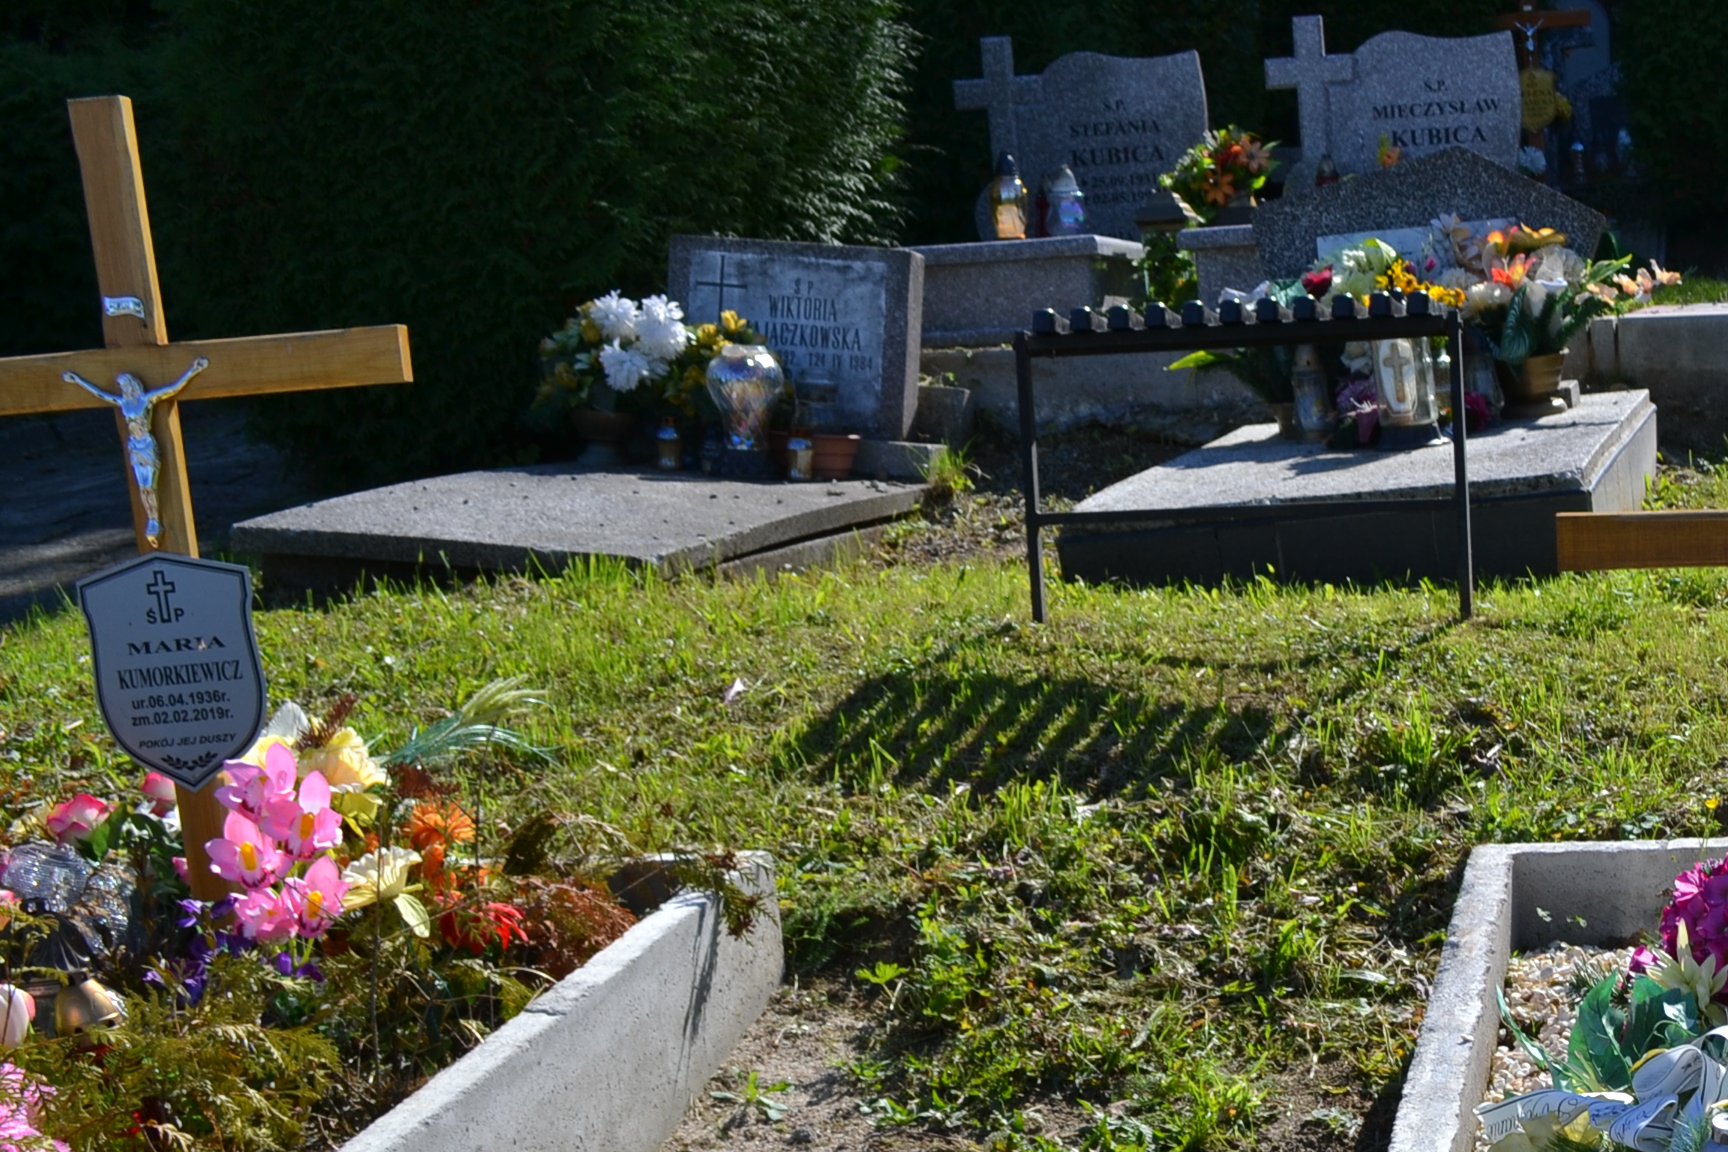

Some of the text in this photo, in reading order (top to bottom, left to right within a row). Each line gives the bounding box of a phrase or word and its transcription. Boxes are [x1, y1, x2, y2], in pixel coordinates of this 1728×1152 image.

[1372, 98, 1500, 119] MIECZYSŁAW
[1069, 119, 1161, 138] STEFANIA
[1392, 126, 1487, 147] KUBICA
[1071, 146, 1164, 167] KUBICA
[768, 295, 837, 323] WIKTORIA
[126, 636, 226, 656] MARIA
[117, 660, 243, 690] KUMORKIEWICZ
[131, 690, 231, 710] ur.06.04.1936r.
[131, 706, 234, 727] zm.02.02.2019r.
[139, 733, 237, 749] POKÓJ JEJ DUSZY
